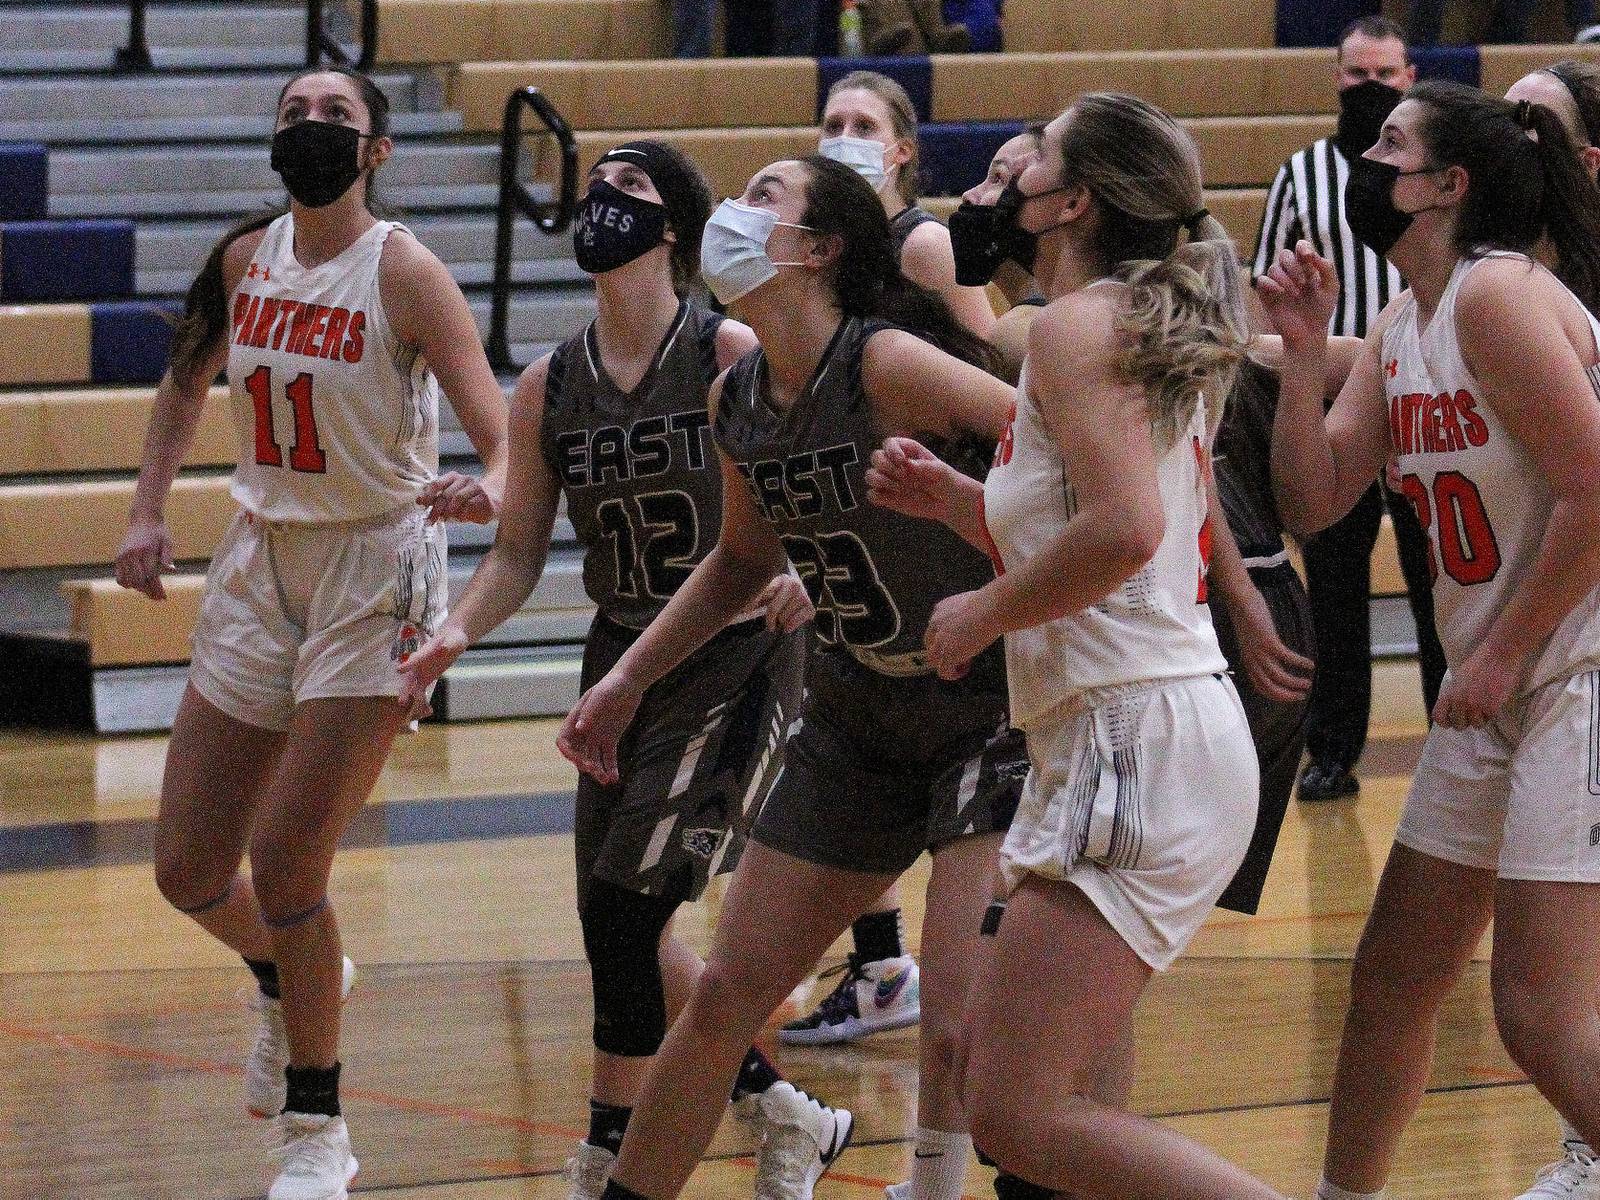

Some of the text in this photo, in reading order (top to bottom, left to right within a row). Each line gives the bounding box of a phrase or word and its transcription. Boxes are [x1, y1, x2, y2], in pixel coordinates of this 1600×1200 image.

[231, 292, 368, 364] PANTHERS
[244, 364, 327, 475] 11
[556, 408, 713, 489] EAST
[736, 442, 859, 522] AST
[596, 489, 700, 600] 12
